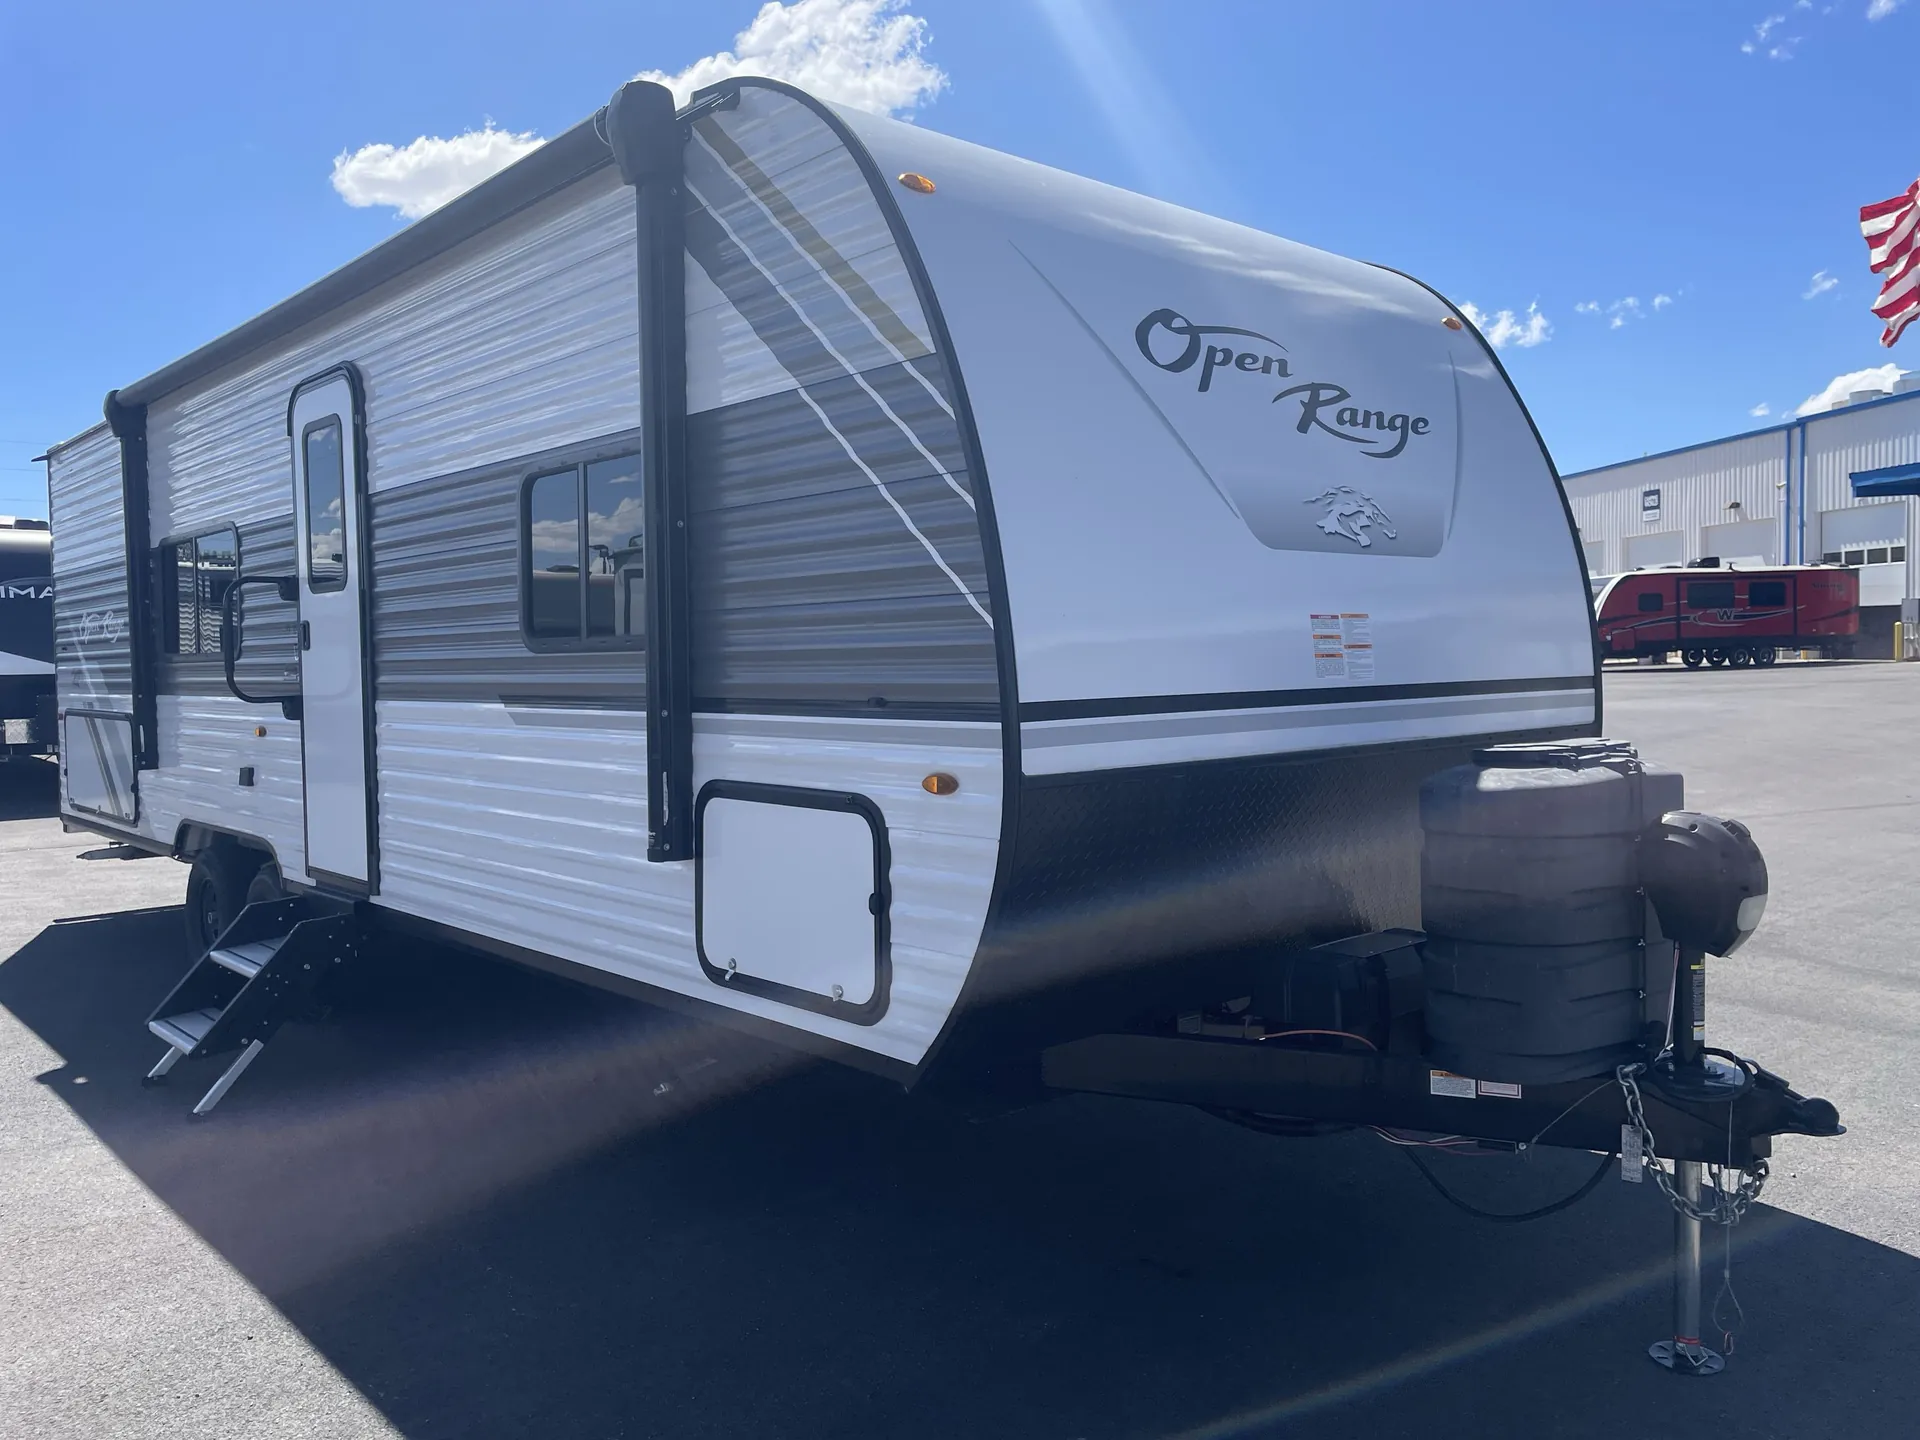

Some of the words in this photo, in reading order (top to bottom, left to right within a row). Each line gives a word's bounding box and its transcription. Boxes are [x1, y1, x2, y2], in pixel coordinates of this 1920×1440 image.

[1135, 308, 1293, 393] Open
[1271, 382, 1431, 459] Range
[1717, 608, 1734, 622] W
